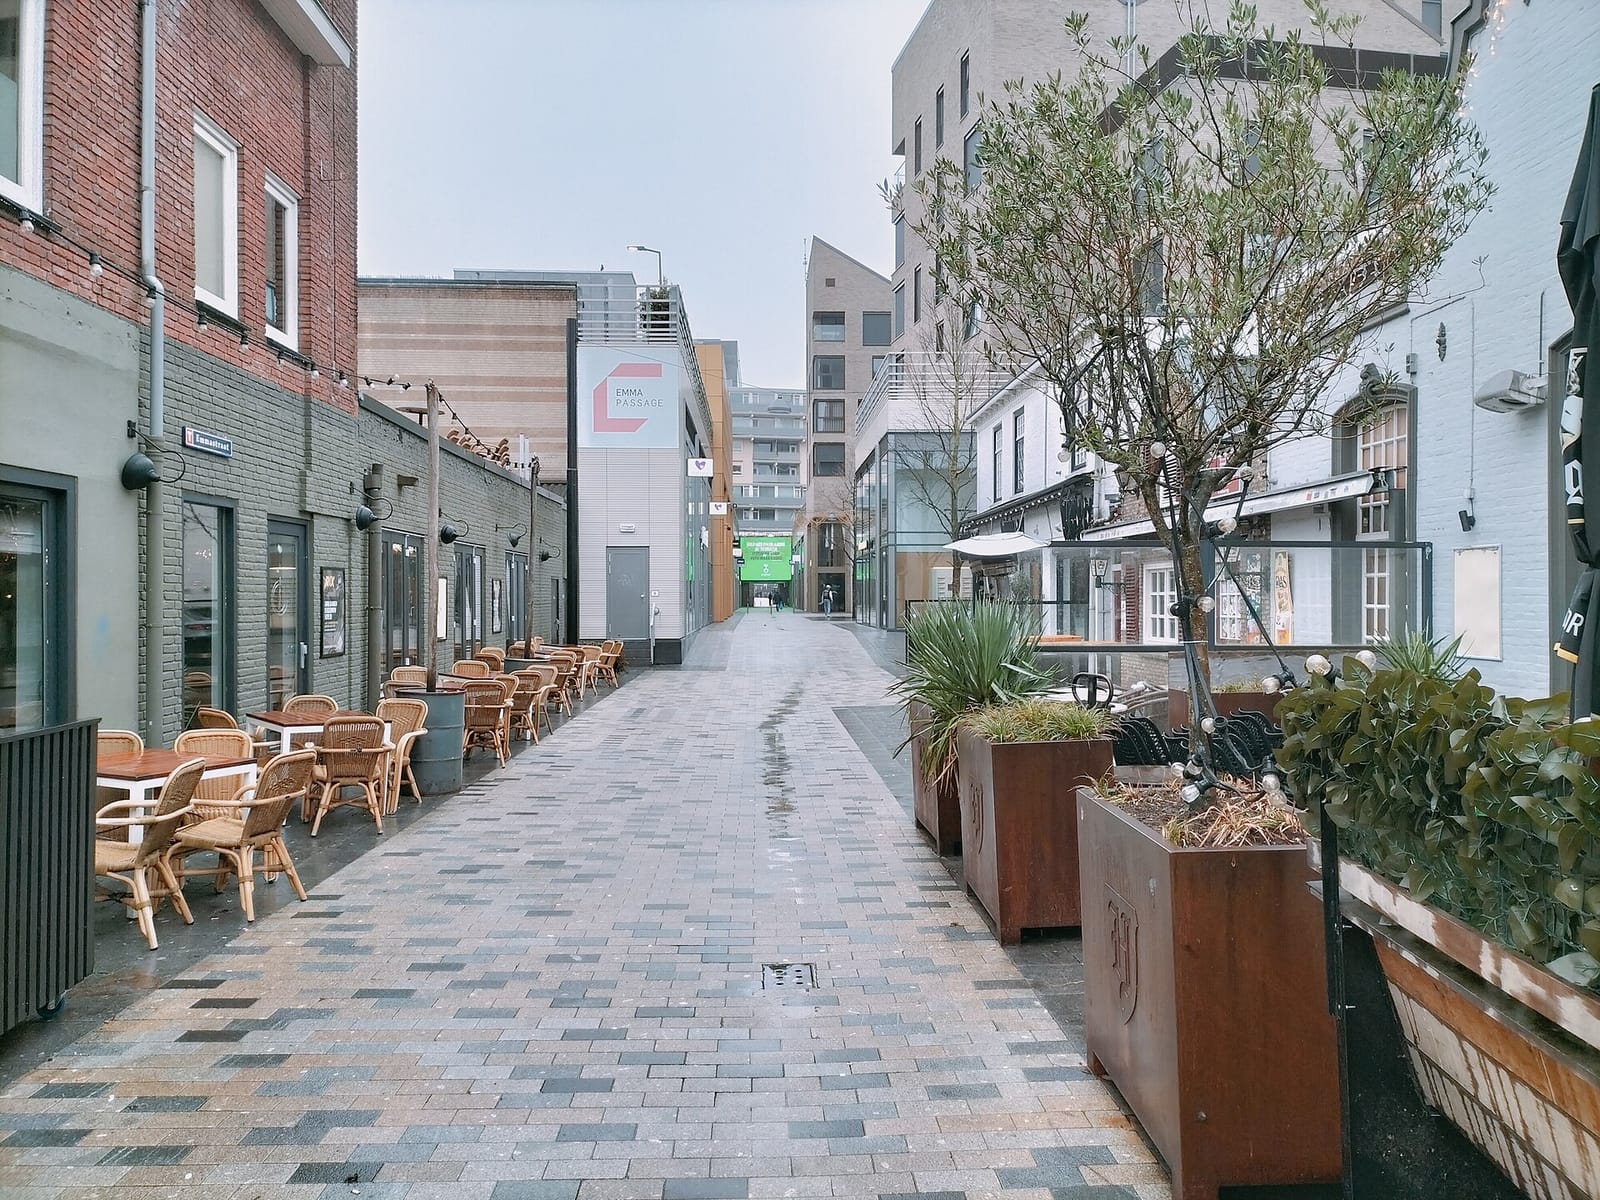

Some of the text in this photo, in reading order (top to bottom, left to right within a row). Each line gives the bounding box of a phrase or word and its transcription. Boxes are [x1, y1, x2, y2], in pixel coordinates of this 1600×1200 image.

[615, 388, 644, 397] EMMA
[615, 398, 664, 407] PASSAGE
[195, 433, 230, 451] Emmastraat
